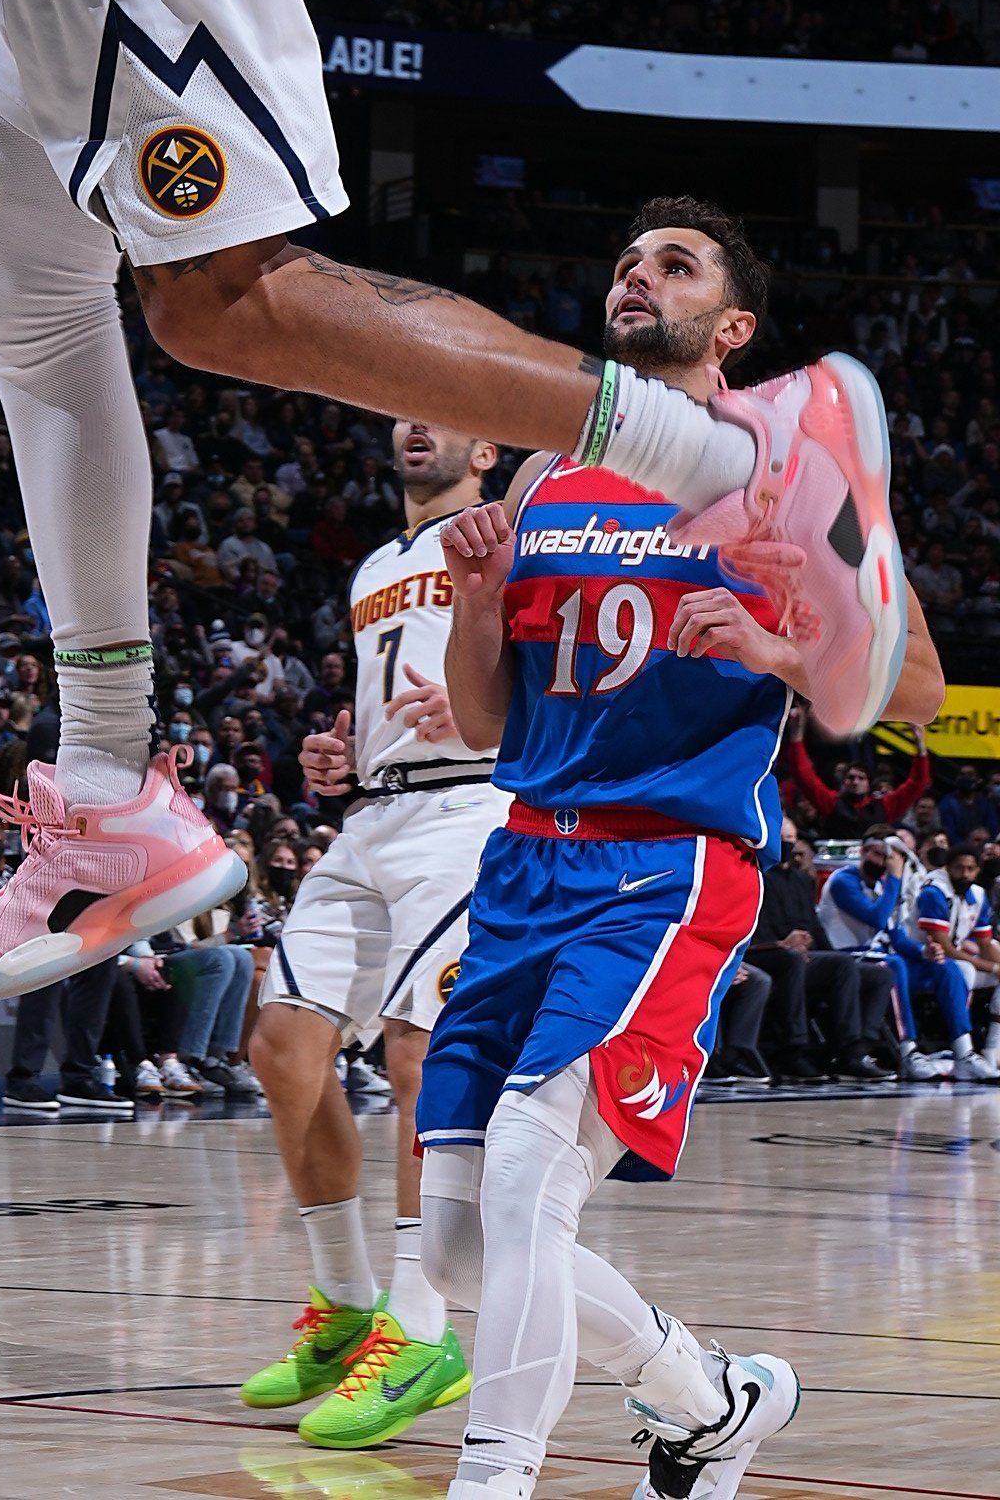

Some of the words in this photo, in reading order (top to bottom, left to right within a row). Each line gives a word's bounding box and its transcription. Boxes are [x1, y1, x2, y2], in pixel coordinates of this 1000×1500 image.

[322, 35, 422, 81] ABLE!
[376, 622, 405, 706] 7
[544, 578, 657, 698] 19
